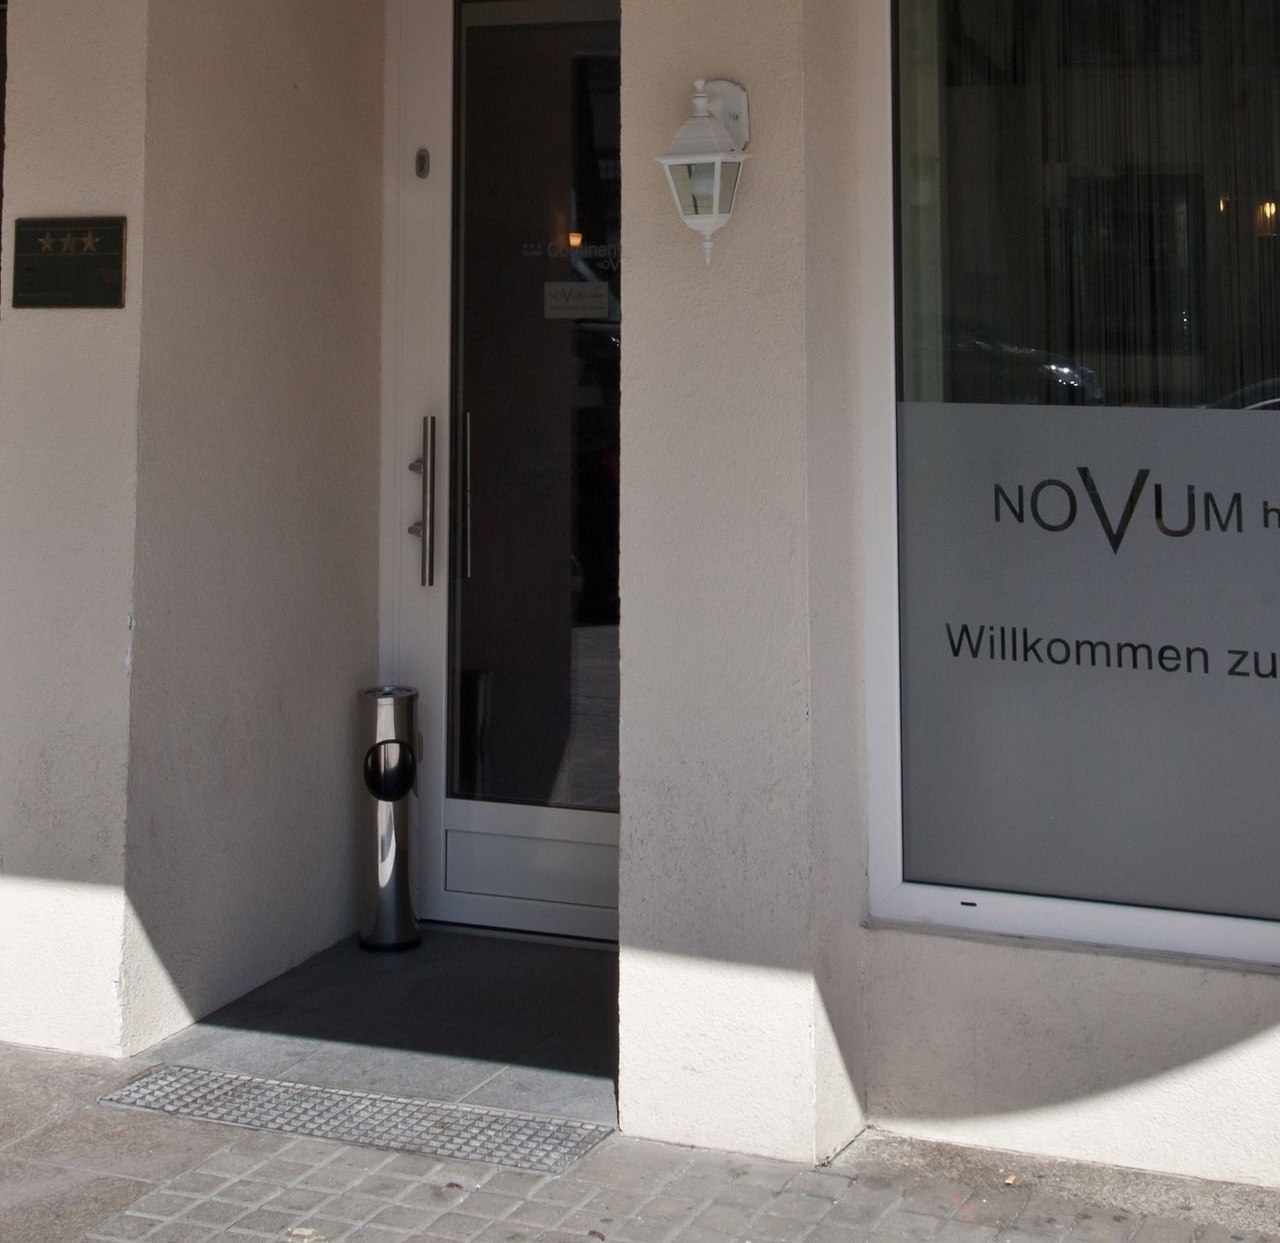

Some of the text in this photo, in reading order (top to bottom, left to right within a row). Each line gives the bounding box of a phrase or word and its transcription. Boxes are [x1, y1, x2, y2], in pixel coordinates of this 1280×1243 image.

[993, 466, 1244, 555] NOVUM
[945, 622, 1210, 675] Willkommen
[1227, 648, 1278, 679] zu
